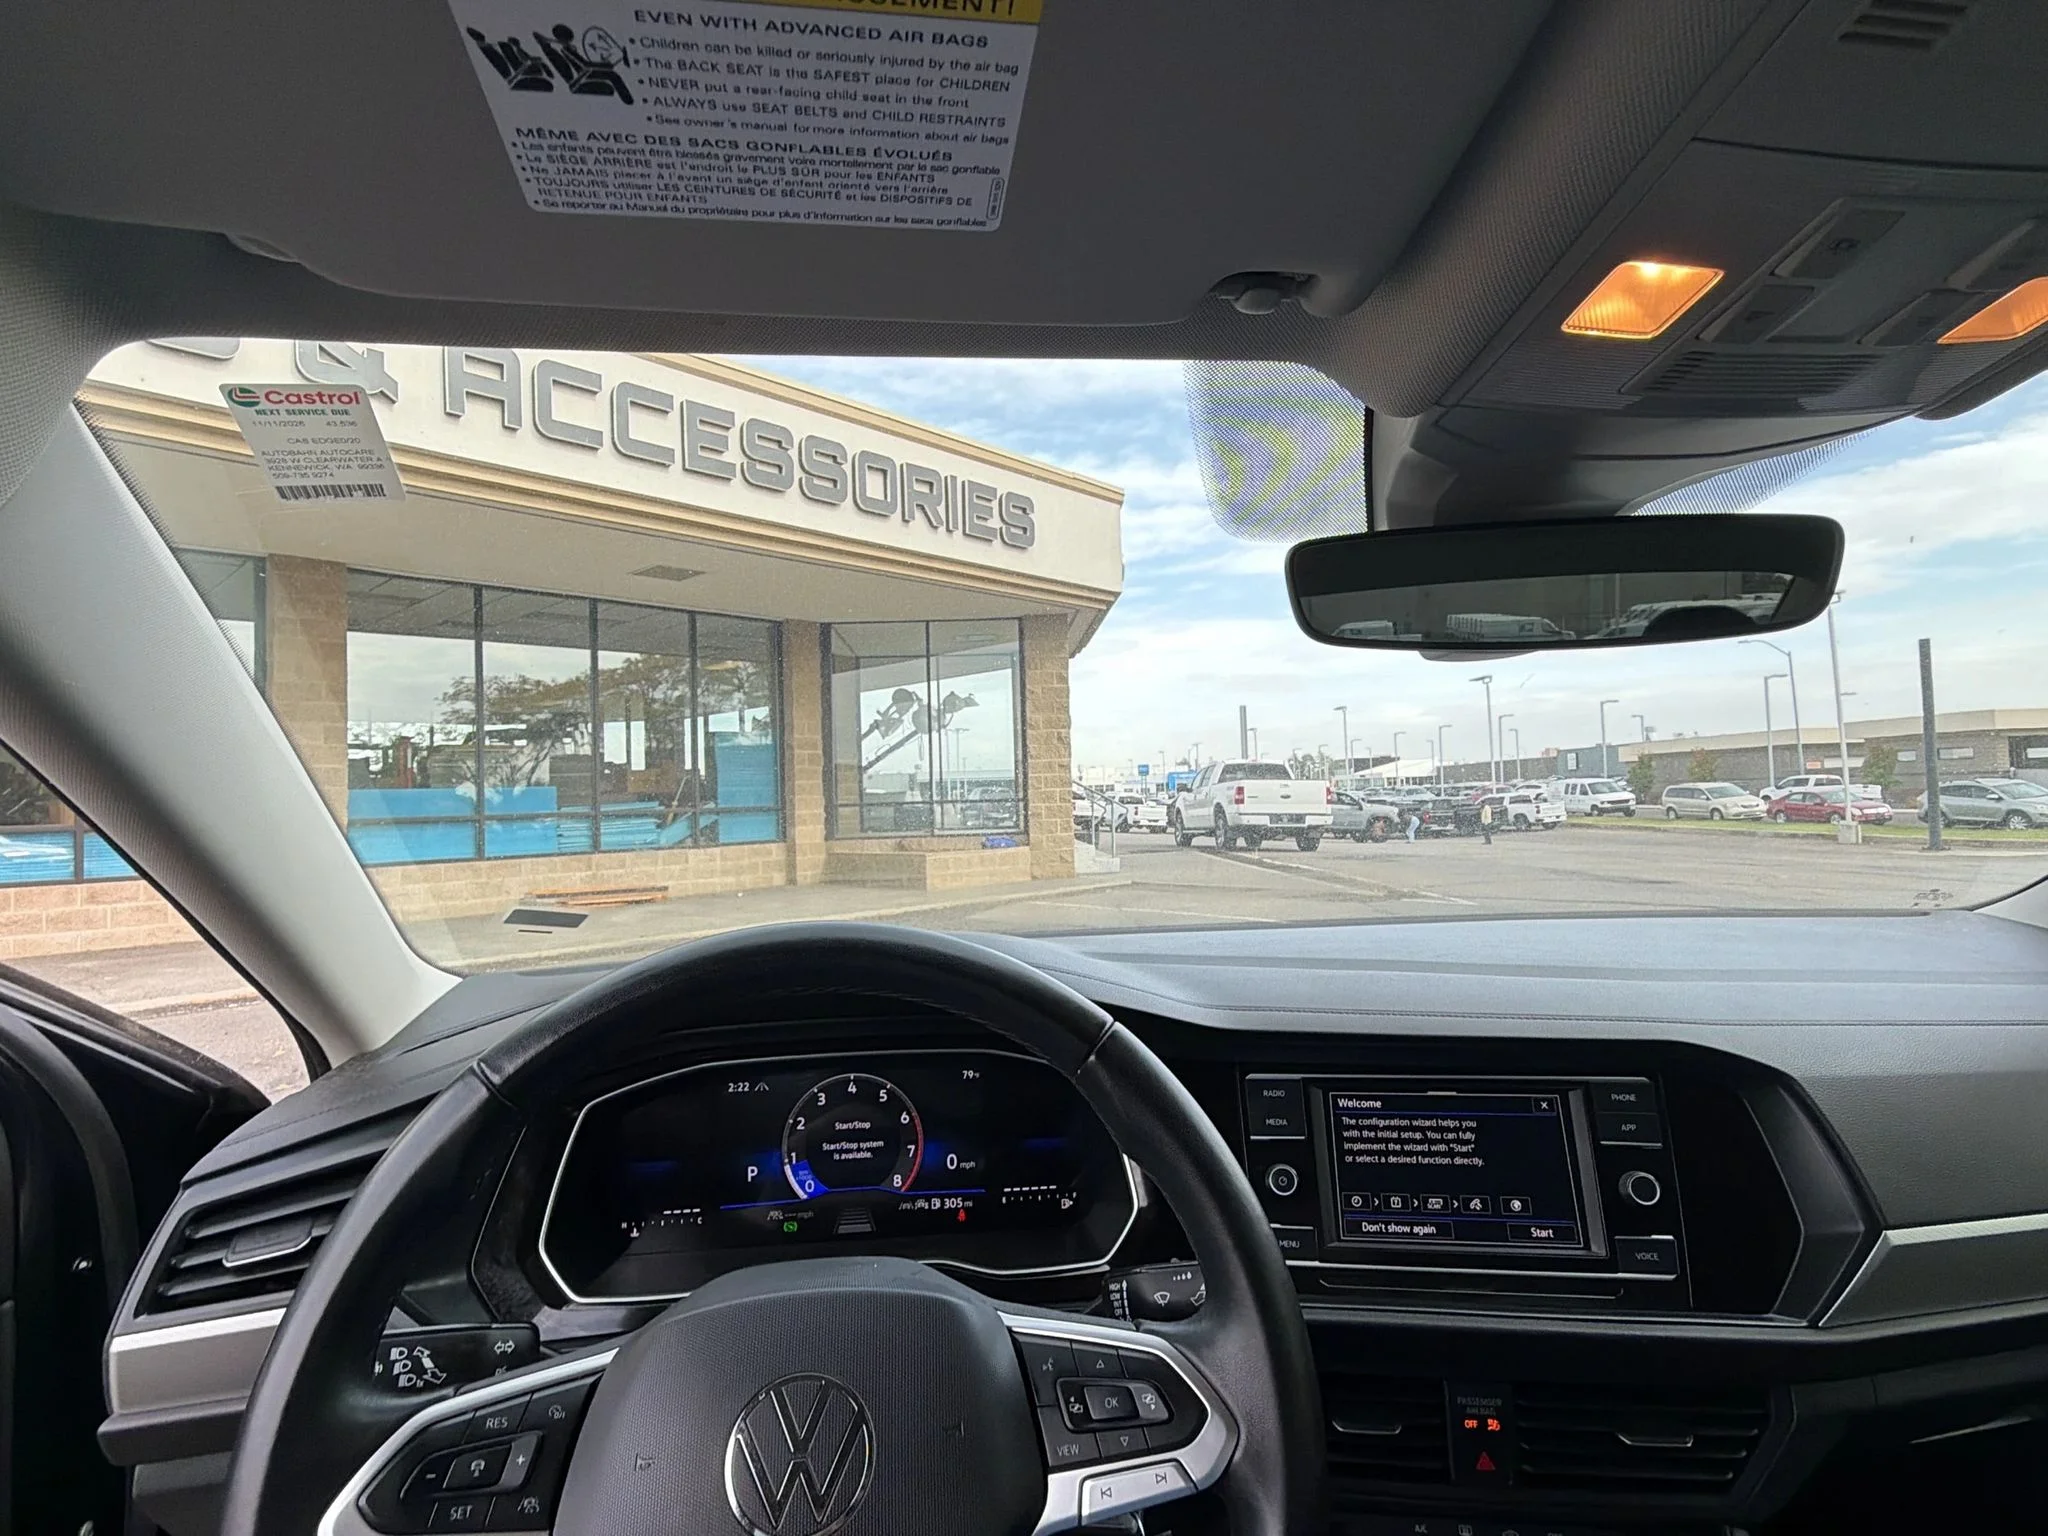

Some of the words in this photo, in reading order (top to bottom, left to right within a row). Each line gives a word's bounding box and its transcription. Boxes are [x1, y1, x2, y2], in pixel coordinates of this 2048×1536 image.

[634, 10, 692, 26] EVEN
[700, 15, 757, 32] WITH
[765, 20, 881, 40] ADVANCED
[889, 30, 924, 43] AIR
[932, 32, 988, 48] BAGS
[640, 37, 700, 53] Children
[705, 44, 729, 54] can
[735, 44, 751, 55] be
[757, 46, 792, 58] killed
[797, 50, 810, 59] or
[816, 52, 875, 66] seriously
[880, 56, 924, 70] injured
[929, 57, 944, 70] by
[950, 60, 970, 71] the
[975, 62, 990, 72] air
[995, 63, 1019, 76] bag
[645, 58, 672, 70] The
[678, 61, 720, 73] BACK
[727, 63, 763, 77] SEAT
[769, 67, 780, 77] is
[787, 68, 807, 79] the
[813, 70, 870, 82] SAFEST
[875, 74, 910, 86] place
[917, 76, 934, 87] for
[940, 77, 1010, 92] CHILDREN
[649, 78, 700, 91] NEVER
[705, 82, 728, 93] put
[734, 85, 740, 93] a
[746, 84, 820, 100] rear-facing
[826, 89, 857, 101] child
[863, 93, 890, 103] seat
[896, 93, 907, 104] in
[913, 93, 932, 105] the
[938, 96, 968, 108] front
[654, 96, 717, 111] ALWAYS
[723, 103, 746, 112] use
[752, 102, 788, 115] SEAT
[794, 105, 838, 118] BELTS
[843, 109, 867, 120] and
[872, 110, 914, 123] CHILD
[919, 112, 1006, 128] RESTRAINTS
[655, 114, 680, 125] See
[684, 118, 737, 129] owner's
[741, 120, 787, 132] manual
[794, 122, 812, 133] for
[813, 126, 844, 135] more
[850, 126, 920, 140] information
[925, 131, 958, 142] about
[963, 134, 977, 143] air
[981, 135, 1009, 146] bags
[515, 126, 579, 142] MÊME
[587, 131, 639, 145] AVEC
[644, 135, 681, 147] DES
[688, 137, 740, 150] SACS
[746, 141, 867, 158] GONFLABLES
[873, 147, 953, 161] ÉVOLUÉS
[546, 153, 588, 166] SIÈGE
[593, 156, 652, 169] ARRIÈRE
[753, 166, 786, 177] PLUS
[824, 170, 851, 181] pour
[856, 170, 873, 181] les
[877, 172, 935, 184] ENFANTS
[264, 390, 361, 405] Castrol
[254, 409, 281, 417] NEXT
[285, 409, 329, 417] SERVICE
[331, 409, 351, 417] DUE
[261, 449, 318, 457] AUTOBAHN
[443, 346, 1036, 549] ACCESSORIES
[303, 456, 376, 464] CLEARWATER
[728, 1083, 750, 1093] 2:22
[848, 1082, 857, 1094] 4
[1263, 1089, 1286, 1097] RADIO
[817, 1093, 826, 1106] 3
[879, 1090, 888, 1102] 5
[1611, 1093, 1637, 1102] PHONE
[1337, 1098, 1382, 1109] Welcome
[796, 1117, 805, 1130] 2
[900, 1111, 910, 1124] 6
[1265, 1118, 1288, 1126] MEDIA
[1342, 1117, 1356, 1126] The
[1358, 1117, 1411, 1128] configuration
[1412, 1117, 1437, 1127] wizard
[1438, 1118, 1460, 1129] helps
[1461, 1120, 1477, 1129] you
[835, 1121, 871, 1131] Start/Stop
[1621, 1123, 1637, 1132] APP
[1343, 1129, 1360, 1138] with
[1362, 1129, 1376, 1138] the
[1377, 1130, 1399, 1139] initial
[1400, 1131, 1424, 1141] setup.
[1426, 1131, 1441, 1140] You
[1443, 1132, 1457, 1140] can
[1458, 1131, 1476, 1142] fully
[822, 1142, 859, 1152] Start/Stop
[860, 1140, 884, 1149] system
[907, 1145, 916, 1158] 7
[1344, 1142, 1386, 1152] implement
[1388, 1142, 1401, 1151] the
[1403, 1143, 1428, 1152] wizard
[1430, 1143, 1448, 1152] with
[790, 1152, 797, 1164] 1
[833, 1152, 840, 1160] is
[840, 1151, 873, 1160] available.
[1345, 1155, 1353, 1163] or
[1355, 1154, 1379, 1163] select
[1380, 1156, 1386, 1164] a
[1387, 1155, 1417, 1164] desired
[1418, 1155, 1452, 1165] function
[1453, 1156, 1485, 1167] directly.
[946, 1154, 958, 1170] 0
[960, 1161, 976, 1171] mph
[747, 1166, 759, 1182] P
[805, 1180, 815, 1193] 0
[893, 1175, 902, 1187] 8
[944, 1197, 963, 1209] 305
[964, 1200, 973, 1208] mi
[1361, 1222, 1386, 1233] Don't
[1388, 1224, 1411, 1234] show
[1412, 1224, 1437, 1236] again
[1530, 1227, 1554, 1238] Start
[1278, 1240, 1300, 1248] MENU
[1635, 1252, 1660, 1261] VOICE
[1104, 1397, 1119, 1409] OK
[485, 1417, 509, 1429] RES
[1463, 1418, 1479, 1429] OFF
[1057, 1443, 1080, 1456] VIEW
[449, 1504, 473, 1521] SET
